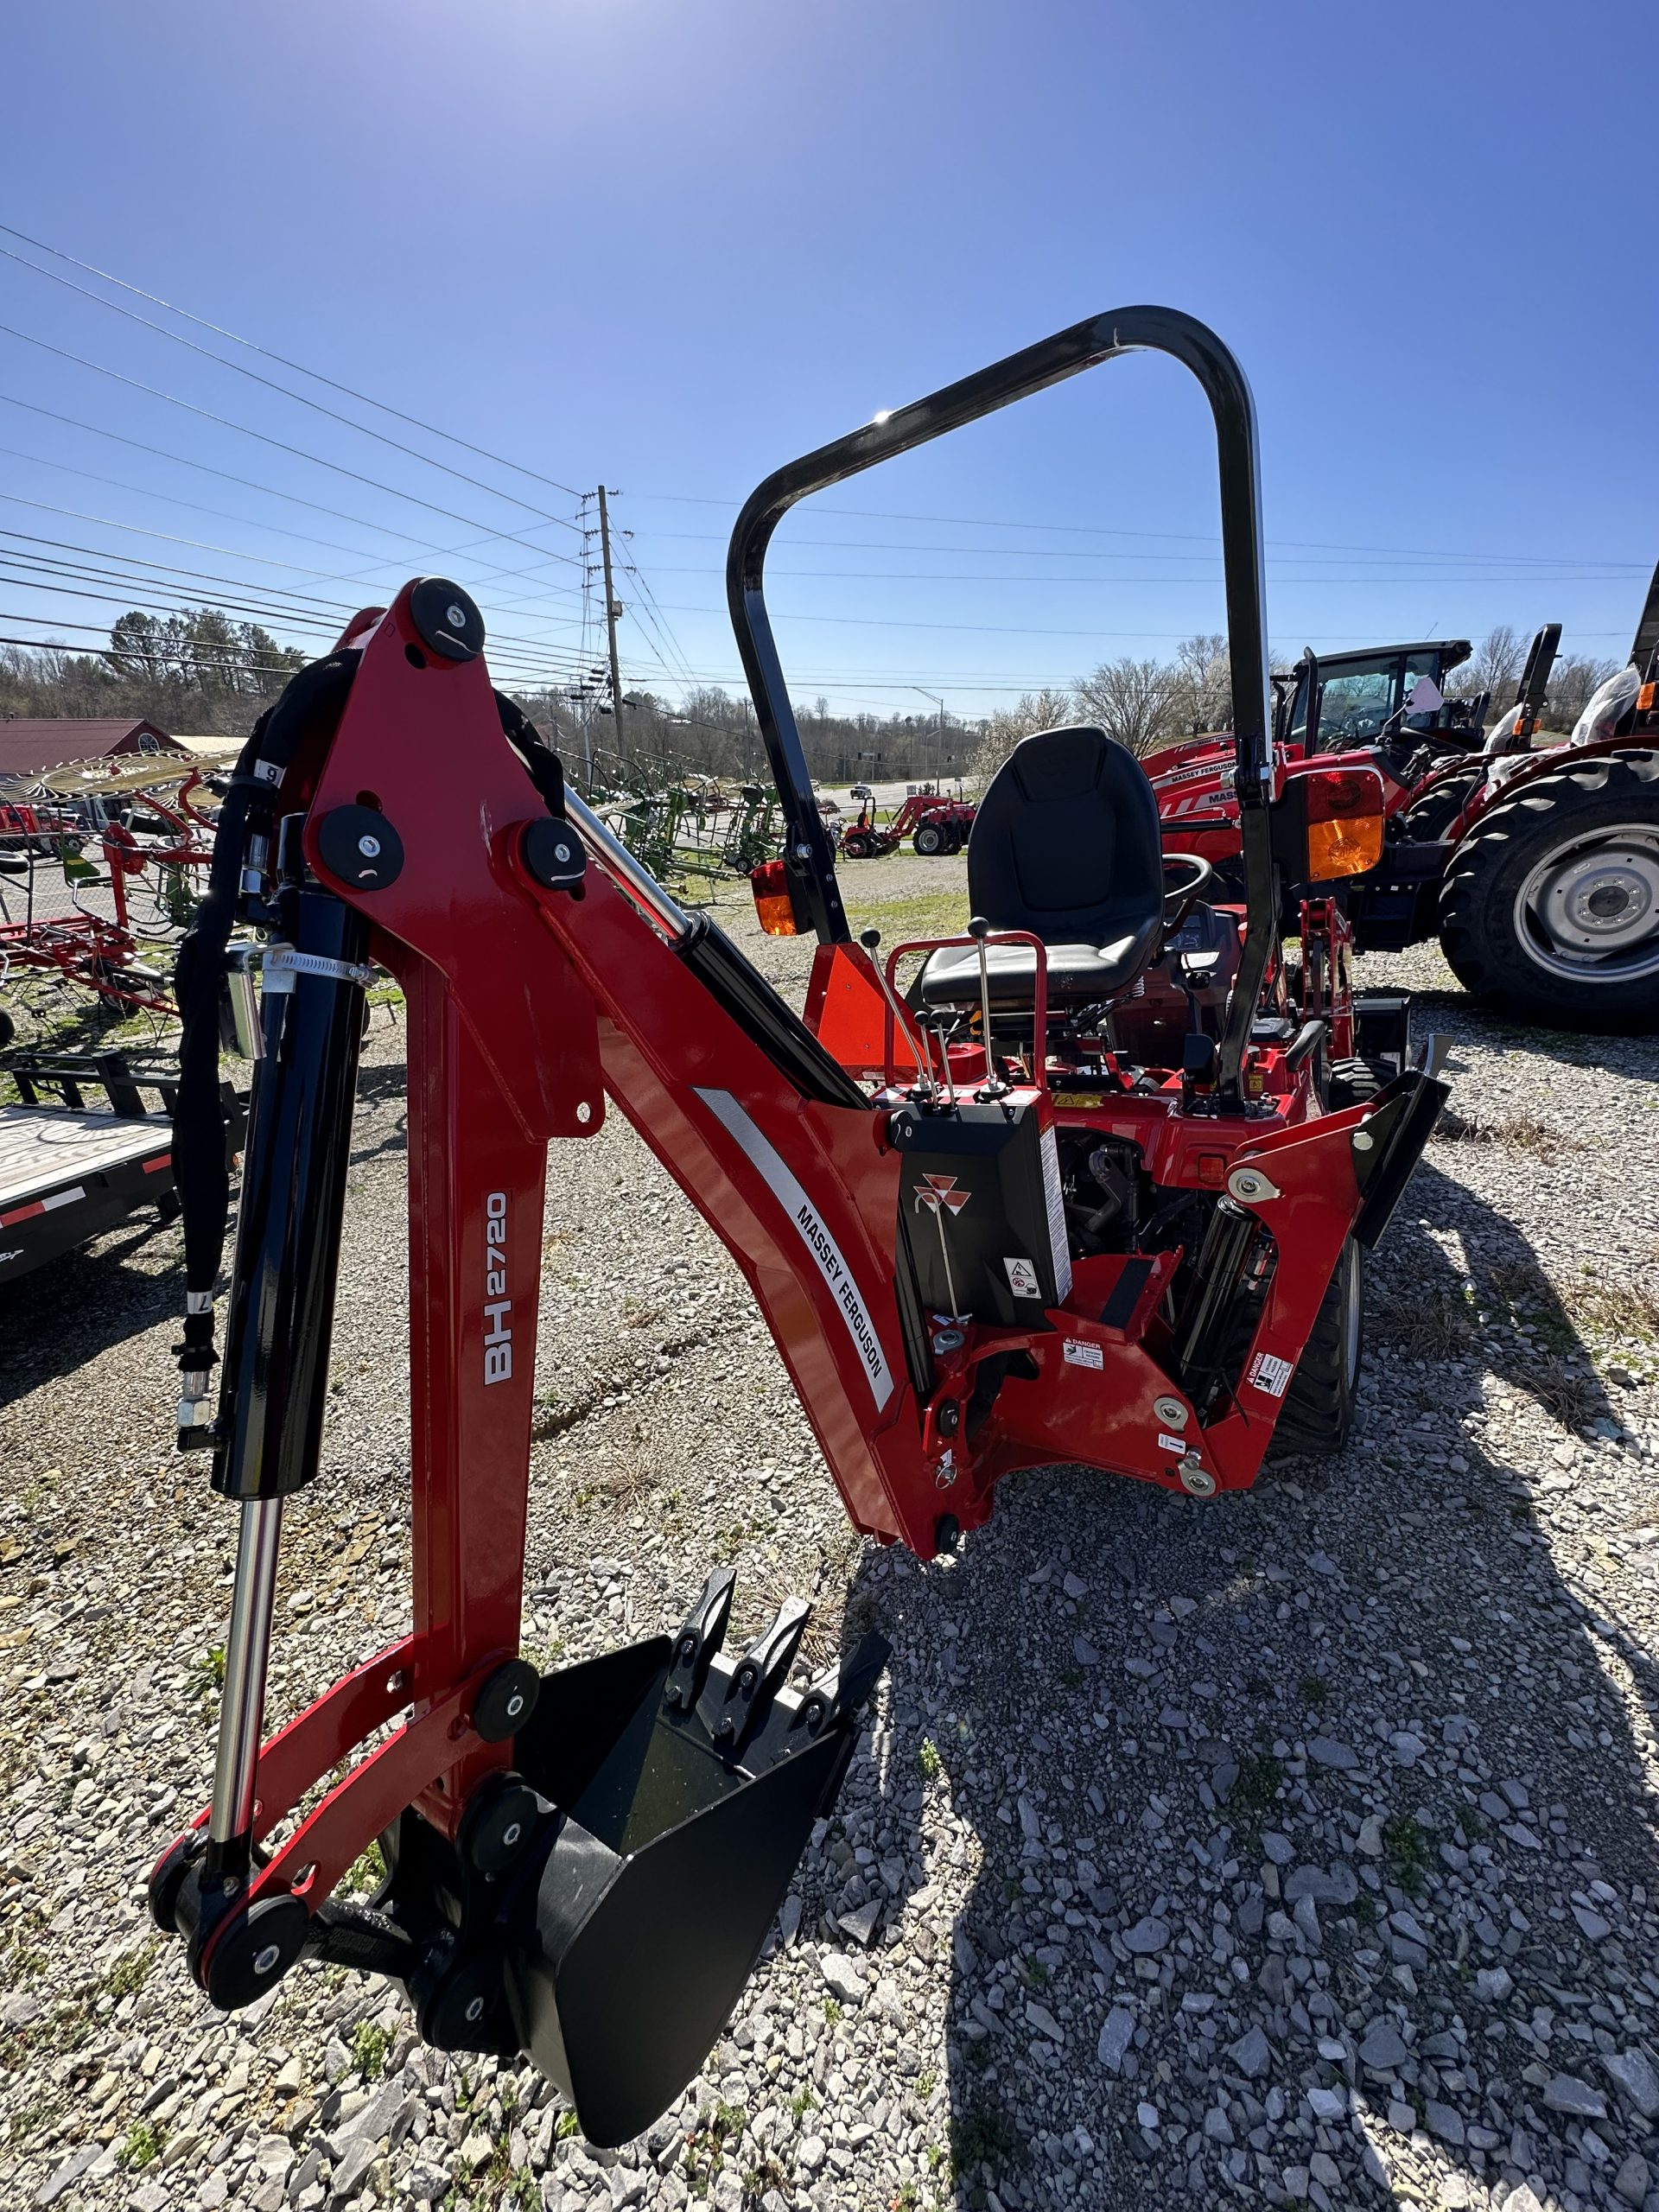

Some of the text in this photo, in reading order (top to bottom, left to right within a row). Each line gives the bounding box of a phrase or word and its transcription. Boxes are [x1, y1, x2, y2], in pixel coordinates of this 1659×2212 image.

[1172, 771, 1199, 783] MASSEY
[797, 1204, 883, 1379] MASSEY FERGUSON
[1072, 1338, 1101, 1350] DANGER
[1249, 1351, 1265, 1377] DANGER
